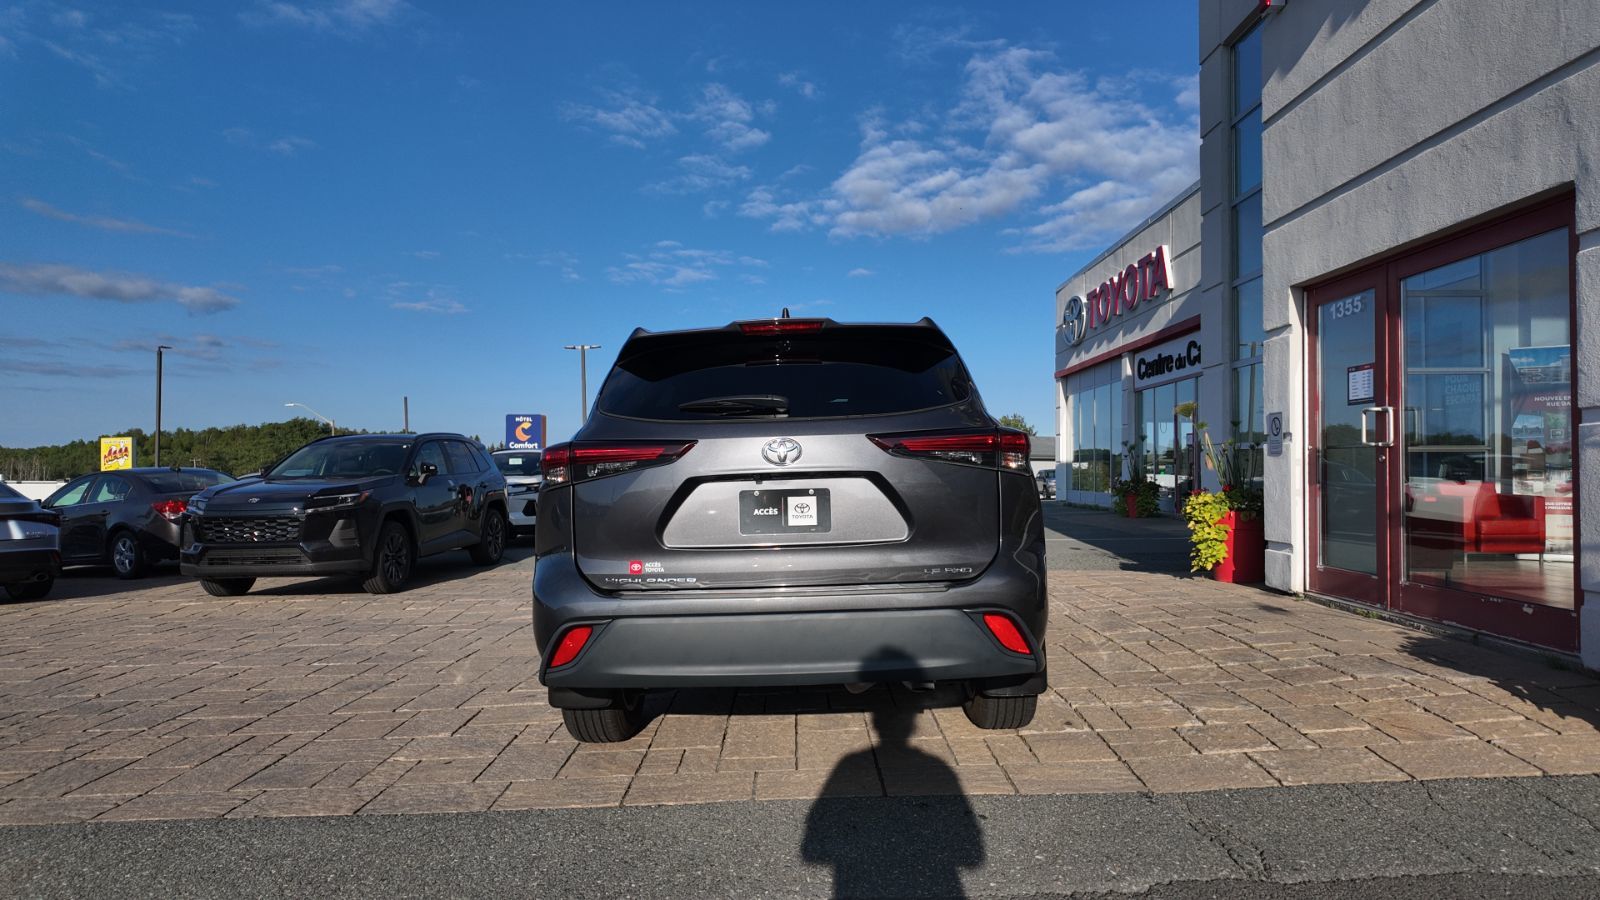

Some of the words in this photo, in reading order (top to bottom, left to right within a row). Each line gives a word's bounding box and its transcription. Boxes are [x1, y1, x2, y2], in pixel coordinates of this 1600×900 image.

[1086, 245, 1174, 329] TOYOTA
[1330, 295, 1362, 320] 1355
[1137, 353, 1173, 380] Centre
[1175, 353, 1186, 370] du
[509, 441, 539, 449] Comfort
[753, 506, 779, 516] ACCÈS
